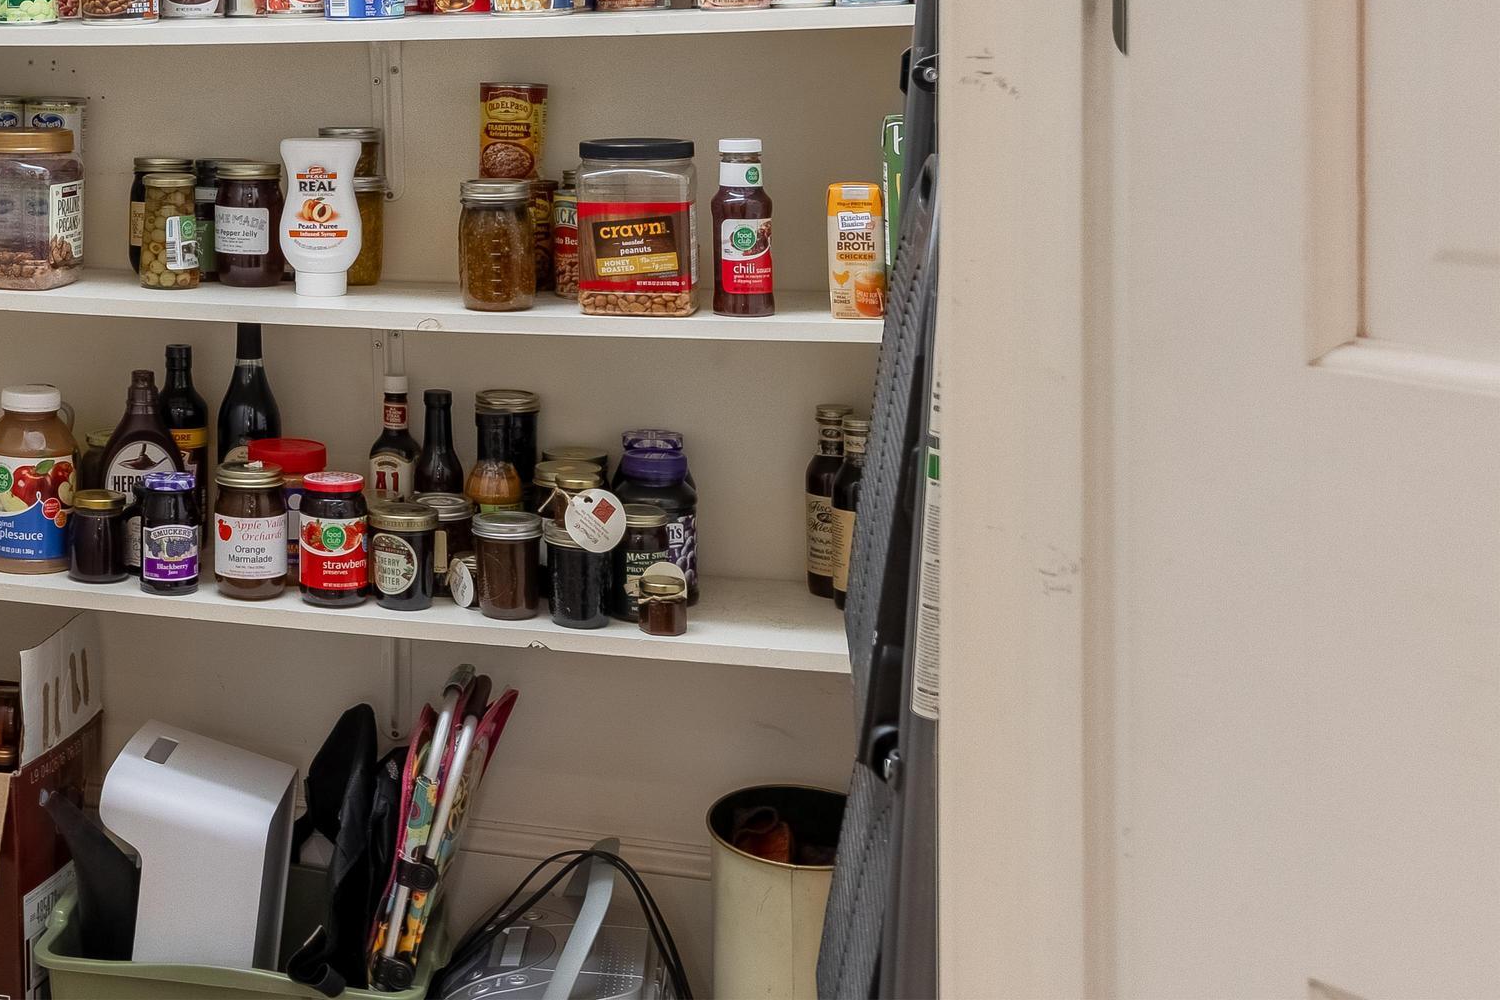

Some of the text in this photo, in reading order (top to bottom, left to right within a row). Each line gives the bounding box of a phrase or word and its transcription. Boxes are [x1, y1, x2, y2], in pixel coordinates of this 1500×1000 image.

[488, 124, 528, 132] TRADITIONAL
[840, 214, 870, 222] Kitchen
[841, 221, 864, 229] Basics
[220, 229, 241, 238] Pepper
[737, 231, 752, 239] food
[839, 231, 872, 241] BONE
[737, 238, 752, 246] club
[837, 241, 875, 251] BROTH
[620, 246, 652, 256] peanuts
[604, 259, 630, 267] HONEY
[601, 265, 635, 274] ROASTED
[733, 262, 755, 274] chili
[233, 520, 262, 531] Apple
[326, 531, 342, 539] food
[327, 537, 342, 545] club
[234, 544, 266, 555] Orange
[228, 555, 273, 564] Marmalade
[626, 552, 649, 562] MAST
